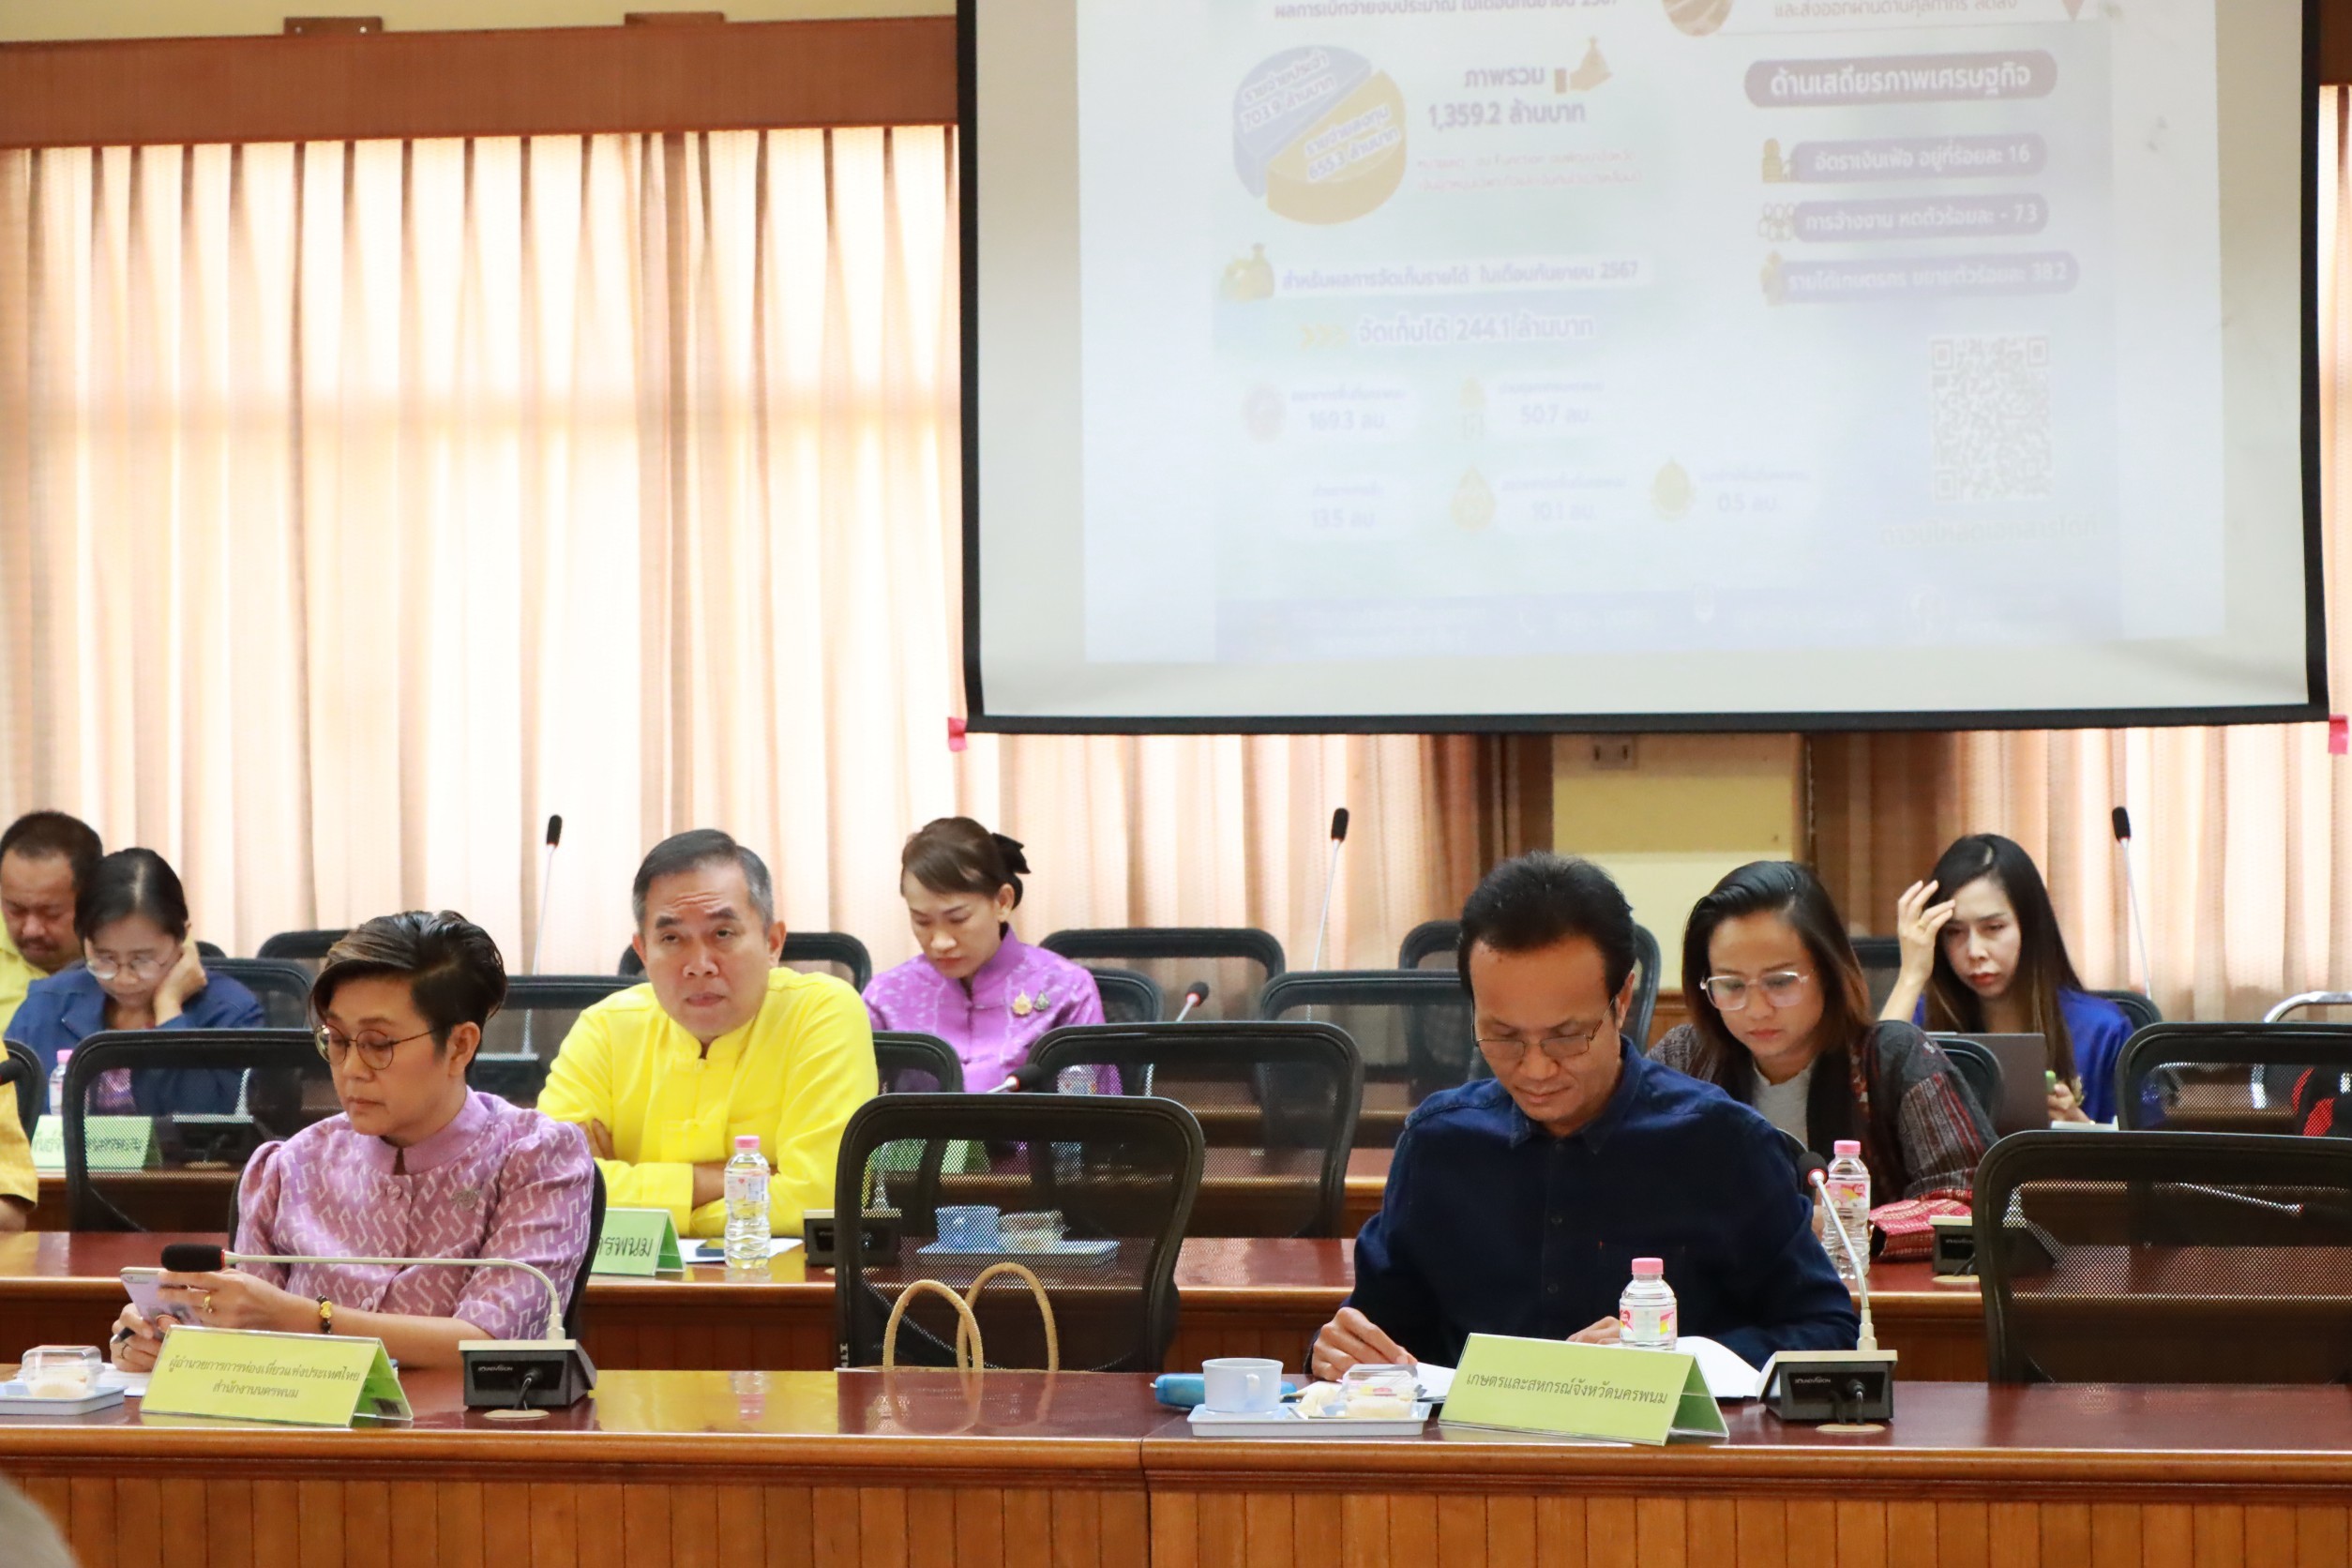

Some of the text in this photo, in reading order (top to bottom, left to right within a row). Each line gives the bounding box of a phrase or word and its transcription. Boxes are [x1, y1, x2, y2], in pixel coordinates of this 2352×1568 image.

[1464, 68, 1545, 87] ภาพรวม
[1771, 61, 2031, 97] ด้านเสถียรภาพเศรษฐกิจ
[1428, 98, 1585, 133] 1,359.2 ล้านบาท
[1600, 260, 1638, 279] 2567
[1359, 314, 1448, 343] จัดเก็บได้
[1517, 311, 1593, 339] ล้านบาท
[169, 1354, 360, 1382] ผู้อำนวยการการท่องเที่ยวแห่งประเทศไทย
[212, 1380, 299, 1399] สำนักงานนครพนม
[1466, 1372, 1667, 1405] เกษตรและสหกรณ์จังหวัดนครพนม
